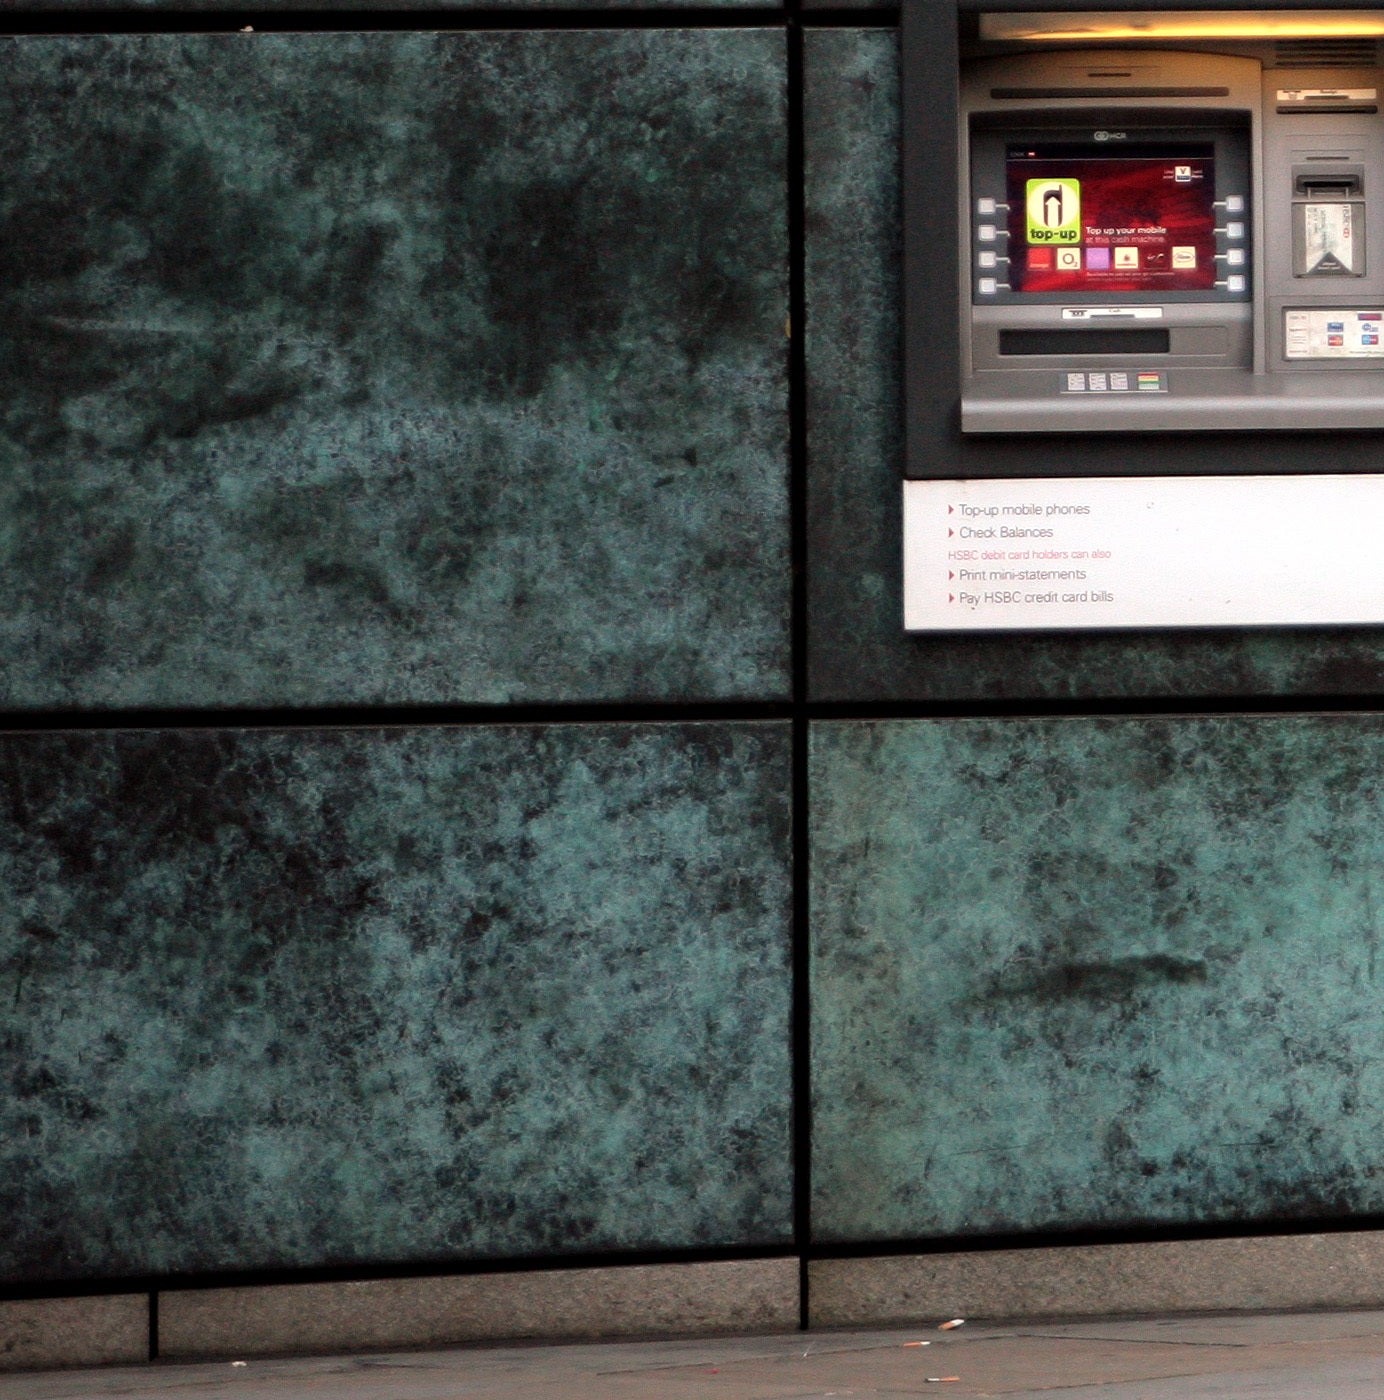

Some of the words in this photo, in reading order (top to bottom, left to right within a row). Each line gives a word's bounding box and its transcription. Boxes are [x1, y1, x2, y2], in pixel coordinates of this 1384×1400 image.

[1030, 229, 1077, 241] top-up
[1086, 226, 1101, 235] Top
[1116, 227, 1136, 235] your
[1137, 226, 1167, 234] mobile
[958, 503, 1000, 519] Top-up
[1001, 503, 1043, 516] mobile
[1045, 503, 1091, 517] phones
[959, 525, 997, 539] Check
[999, 525, 1054, 539] Balances
[959, 568, 987, 581] Print
[989, 569, 1087, 581] mini-statements
[959, 591, 981, 607] Pay
[984, 590, 1021, 604] HSBC
[1024, 592, 1058, 604] credit
[1061, 591, 1088, 603] card
[1090, 591, 1114, 603] bills
